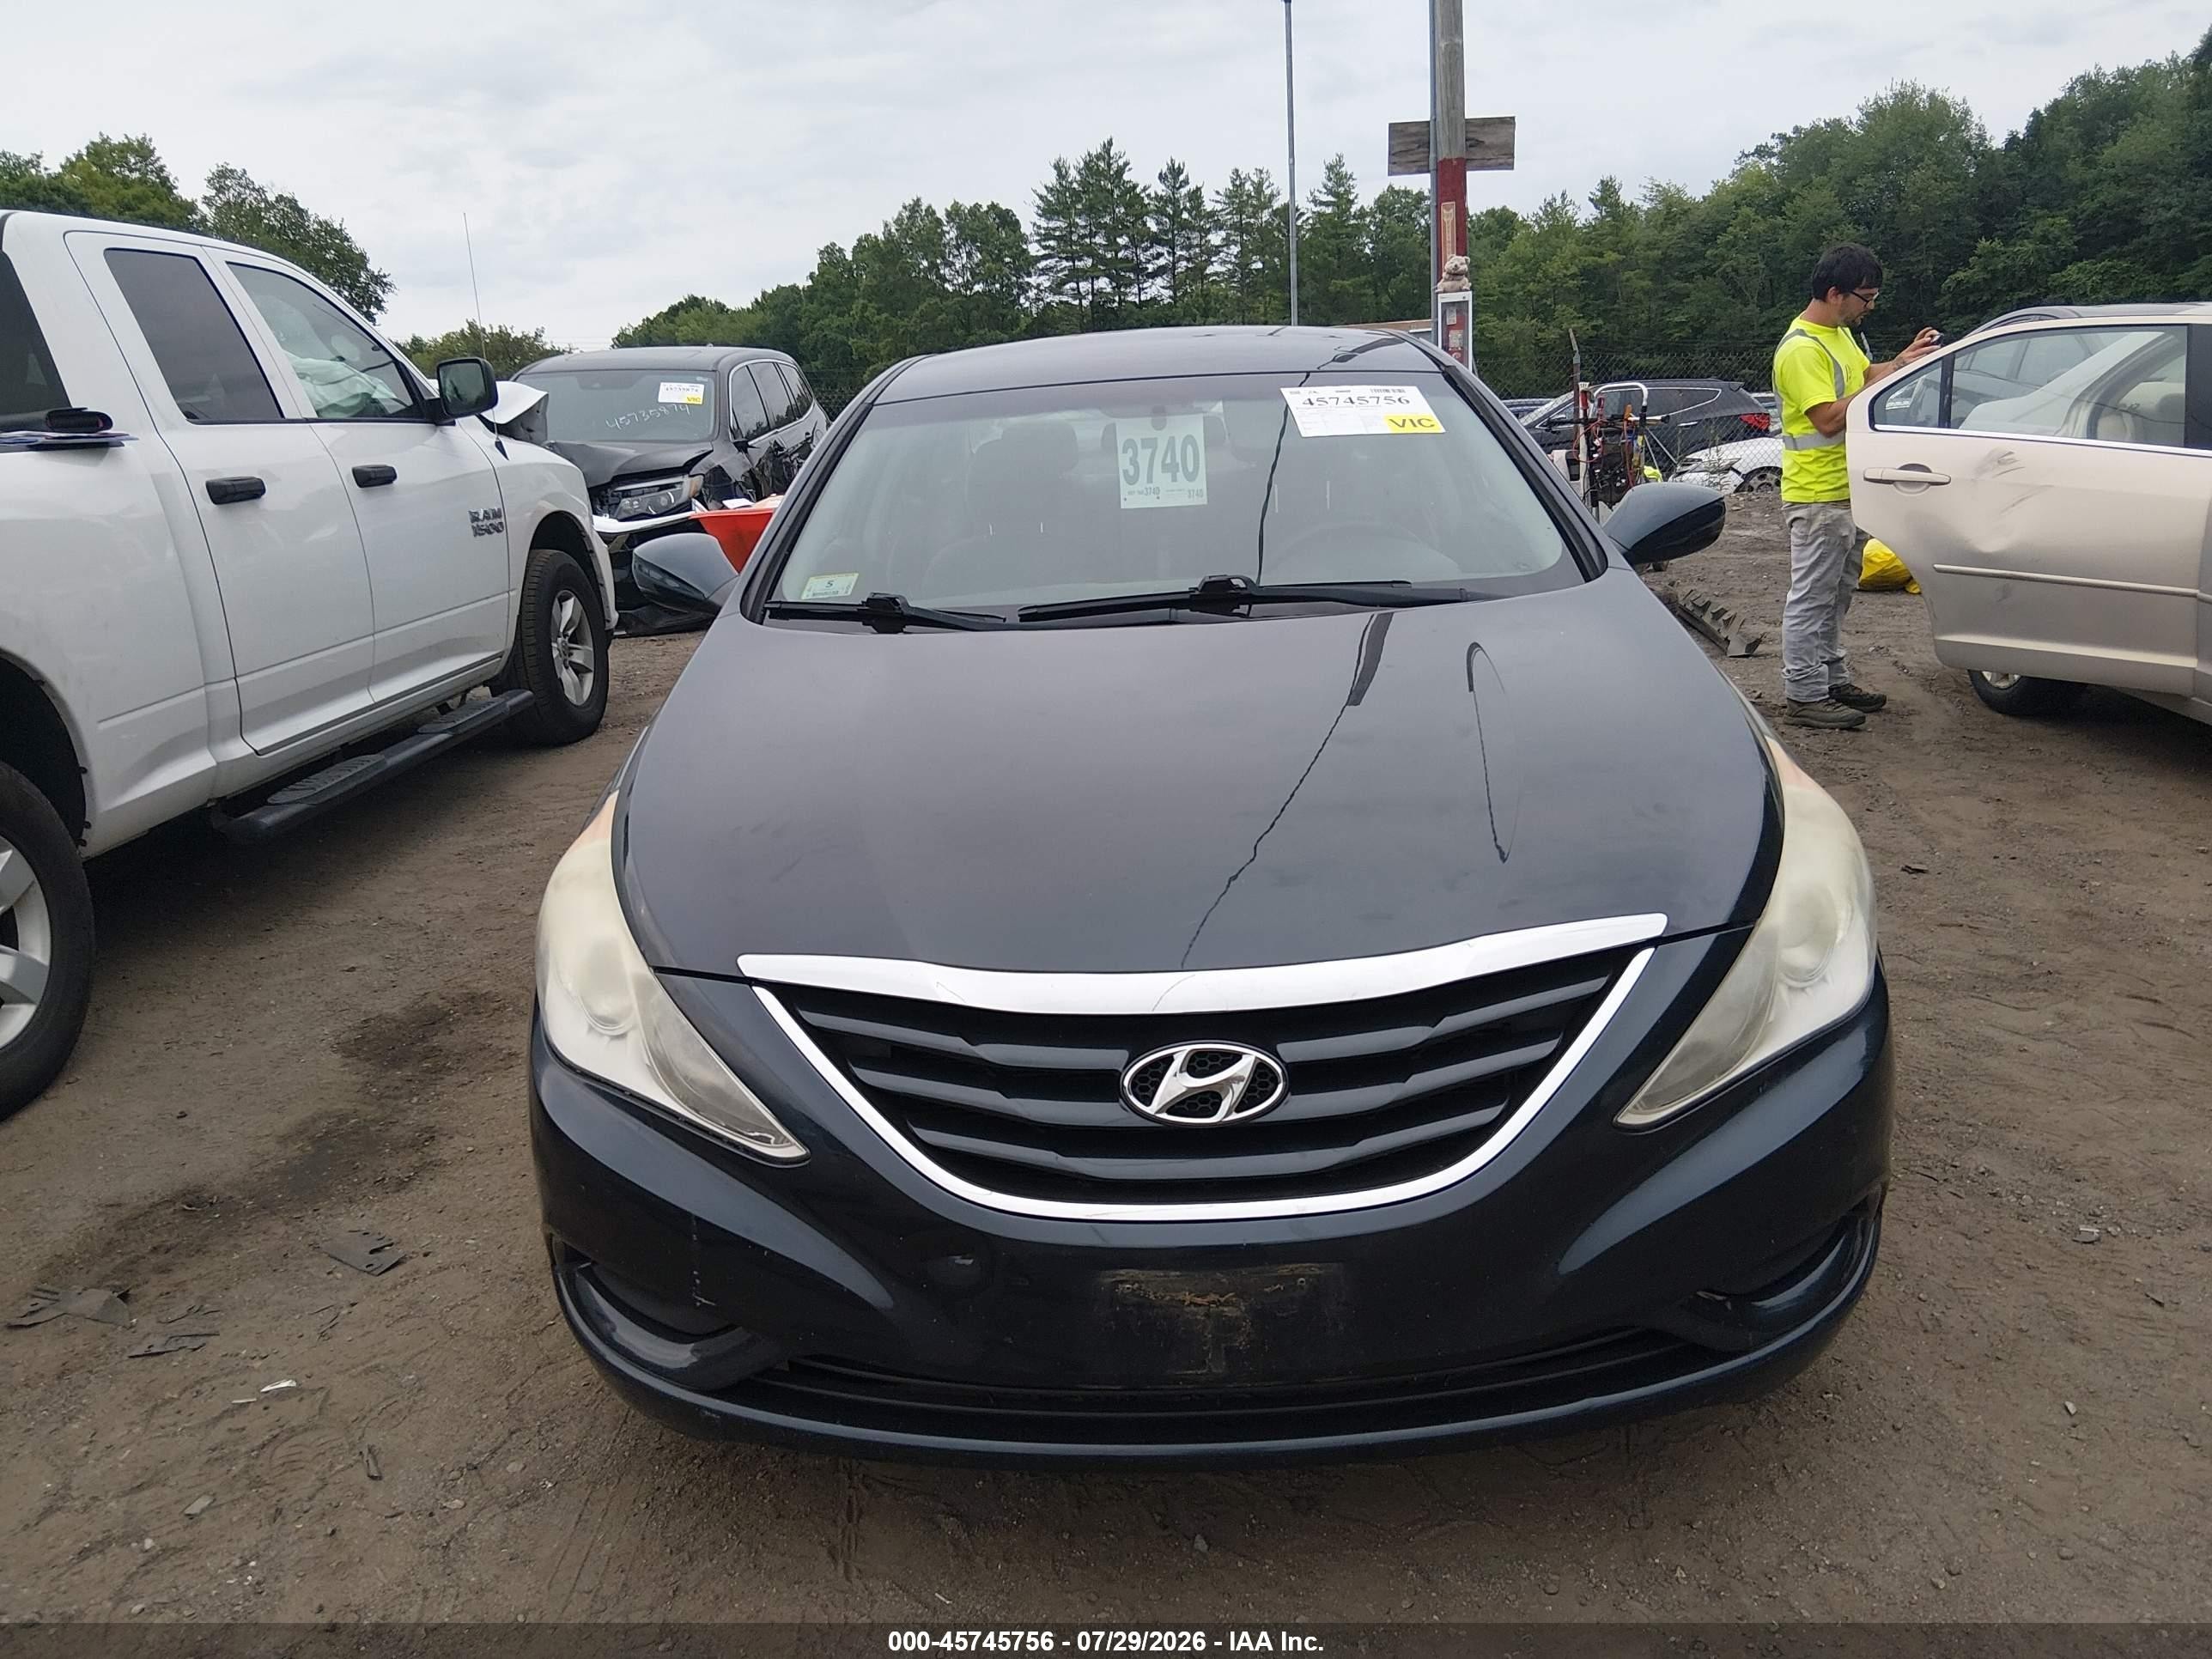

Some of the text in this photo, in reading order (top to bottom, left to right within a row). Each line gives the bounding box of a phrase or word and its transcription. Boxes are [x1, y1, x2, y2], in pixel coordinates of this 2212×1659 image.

[1302, 395, 1411, 406] 45745756
[1389, 417, 1436, 428] VIC
[1121, 434, 1200, 486] 3740
[468, 507, 502, 524] RAM
[471, 521, 505, 538] 1500
